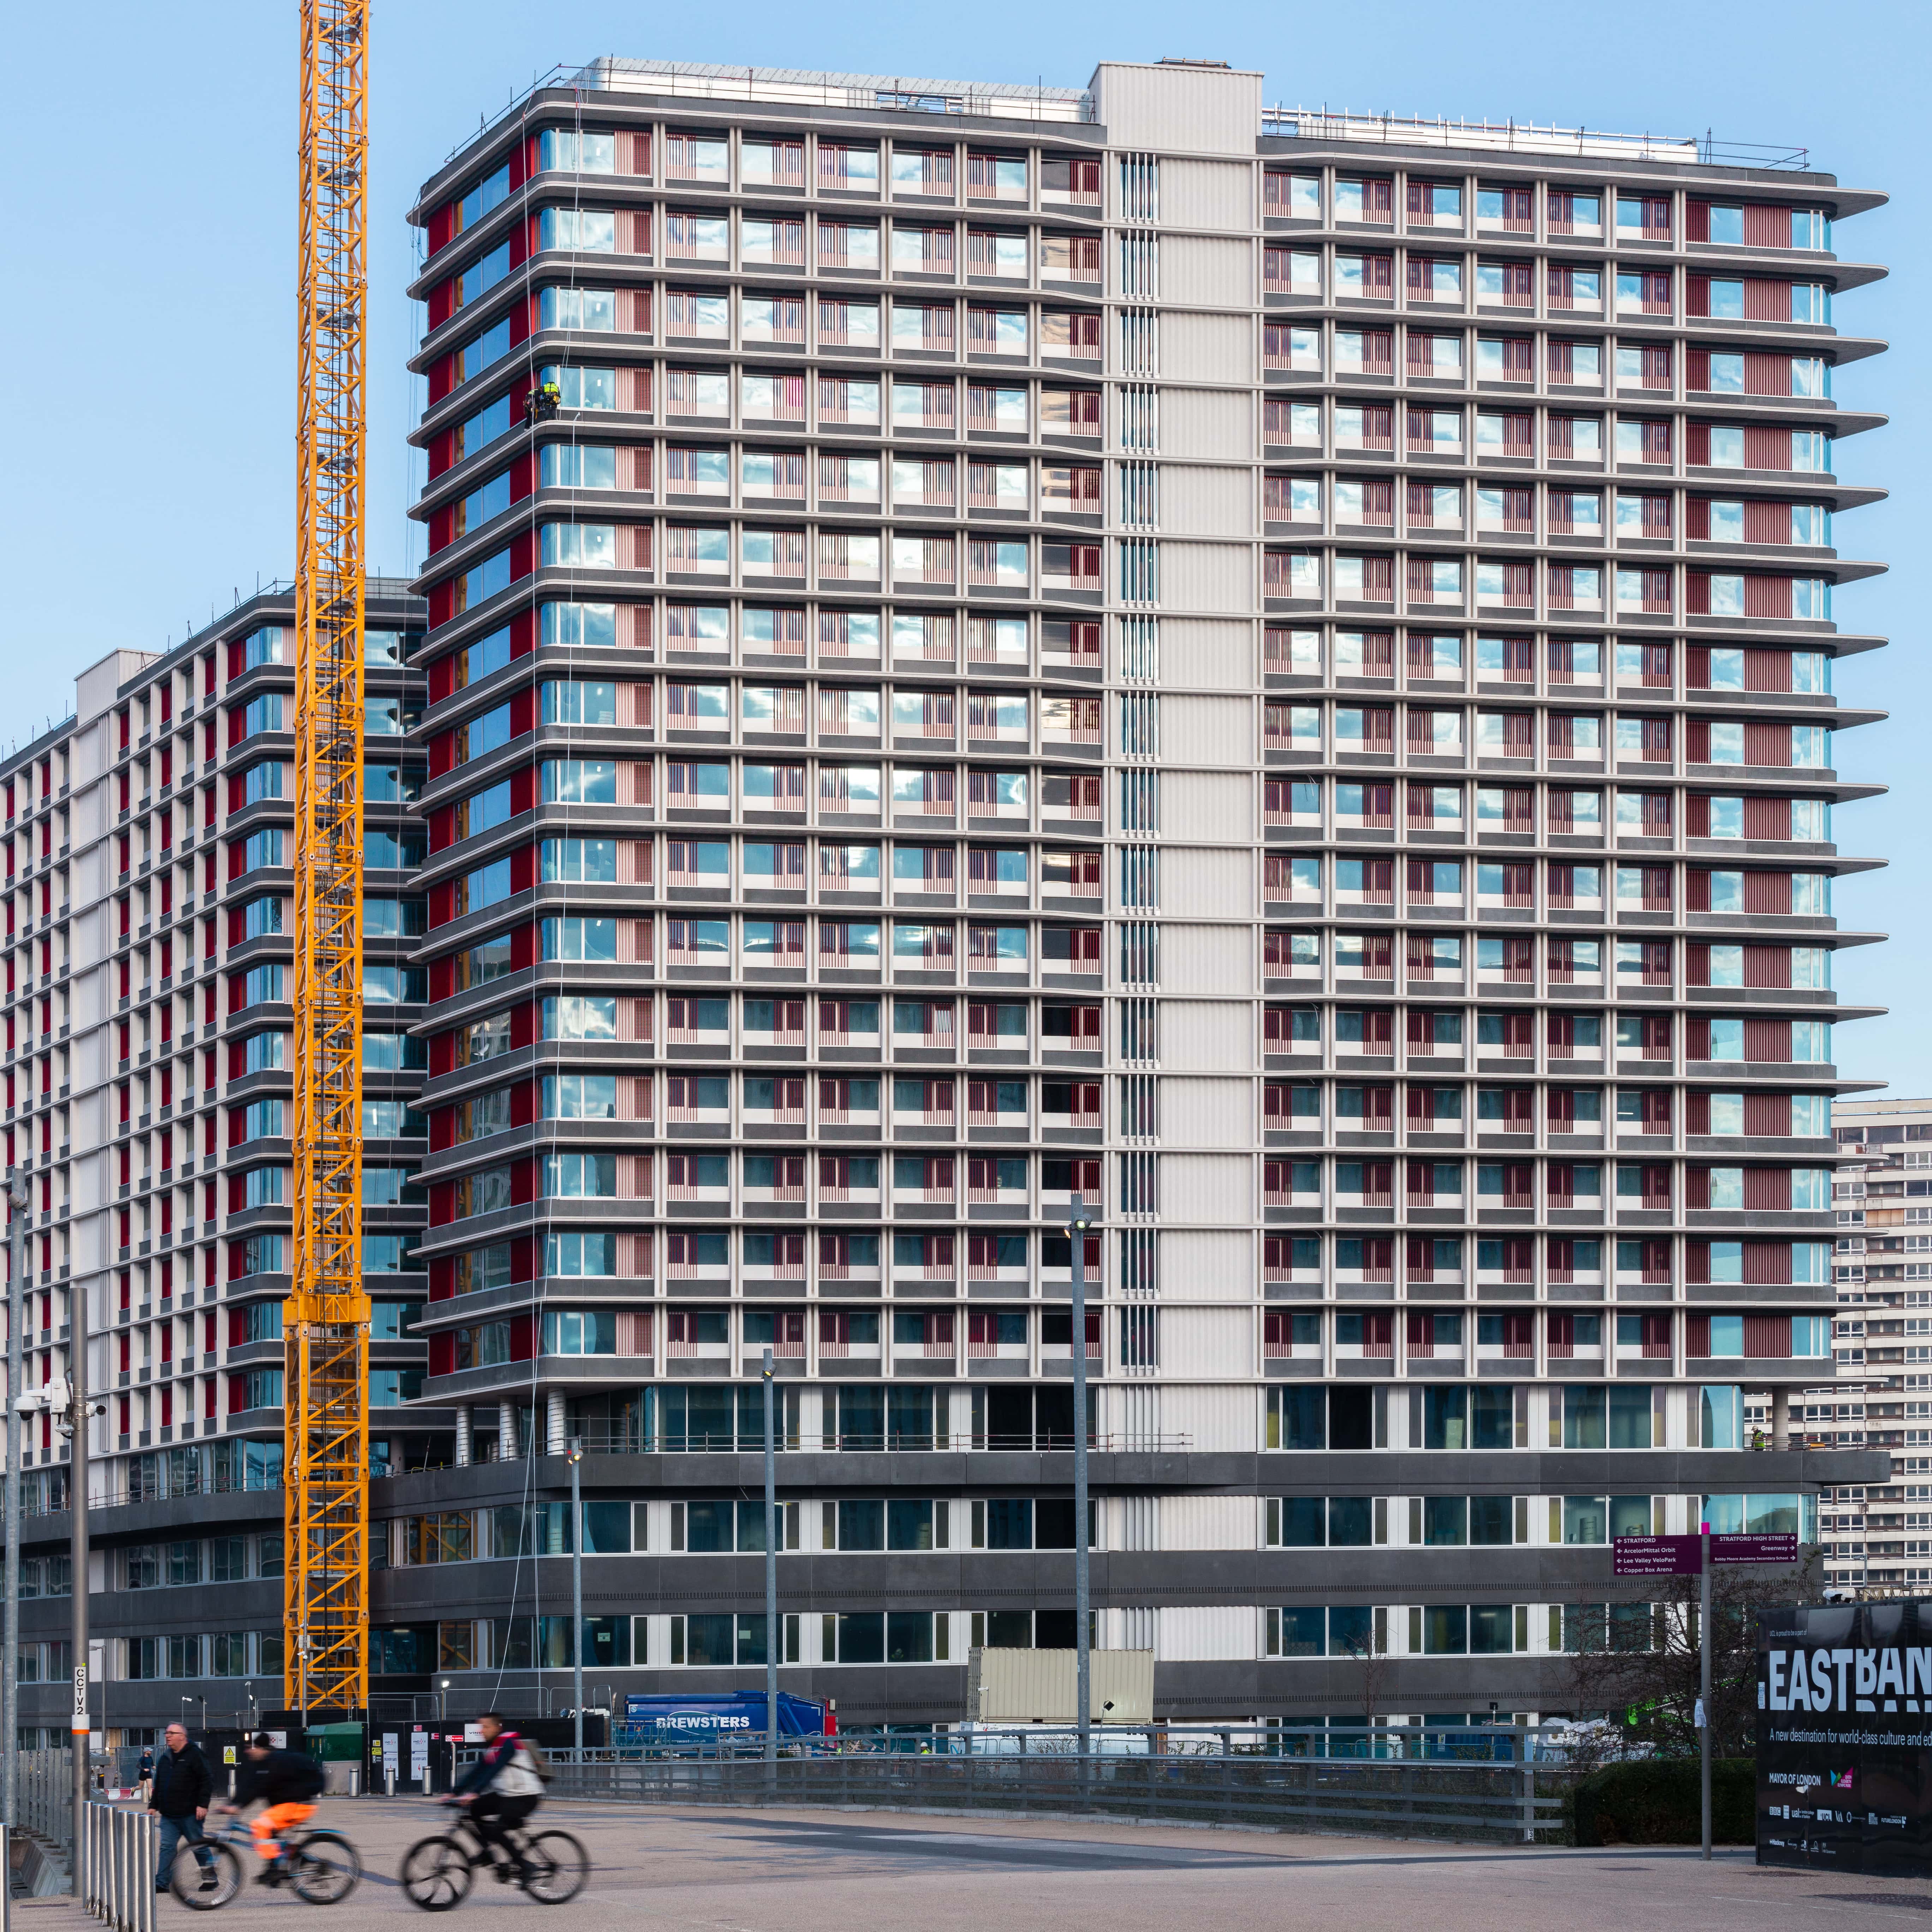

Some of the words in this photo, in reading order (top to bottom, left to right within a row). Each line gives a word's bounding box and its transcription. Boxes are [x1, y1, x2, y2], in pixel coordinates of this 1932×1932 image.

[656, 1717, 750, 1728] BREWSTERS
[1770, 1728, 1774, 1741] A
[1776, 1731, 1789, 1741] new
[1790, 1728, 1826, 1742] destination
[1827, 1729, 1837, 1743] for
[1839, 1729, 1878, 1744] world-class
[1879, 1730, 1905, 1745] culture
[1907, 1731, 1921, 1746] and
[1769, 1773, 1787, 1784] MAYOR
[1788, 1774, 1795, 1784] OF
[1797, 1775, 1821, 1785] LONDON
[1770, 1807, 1780, 1815] BBC
